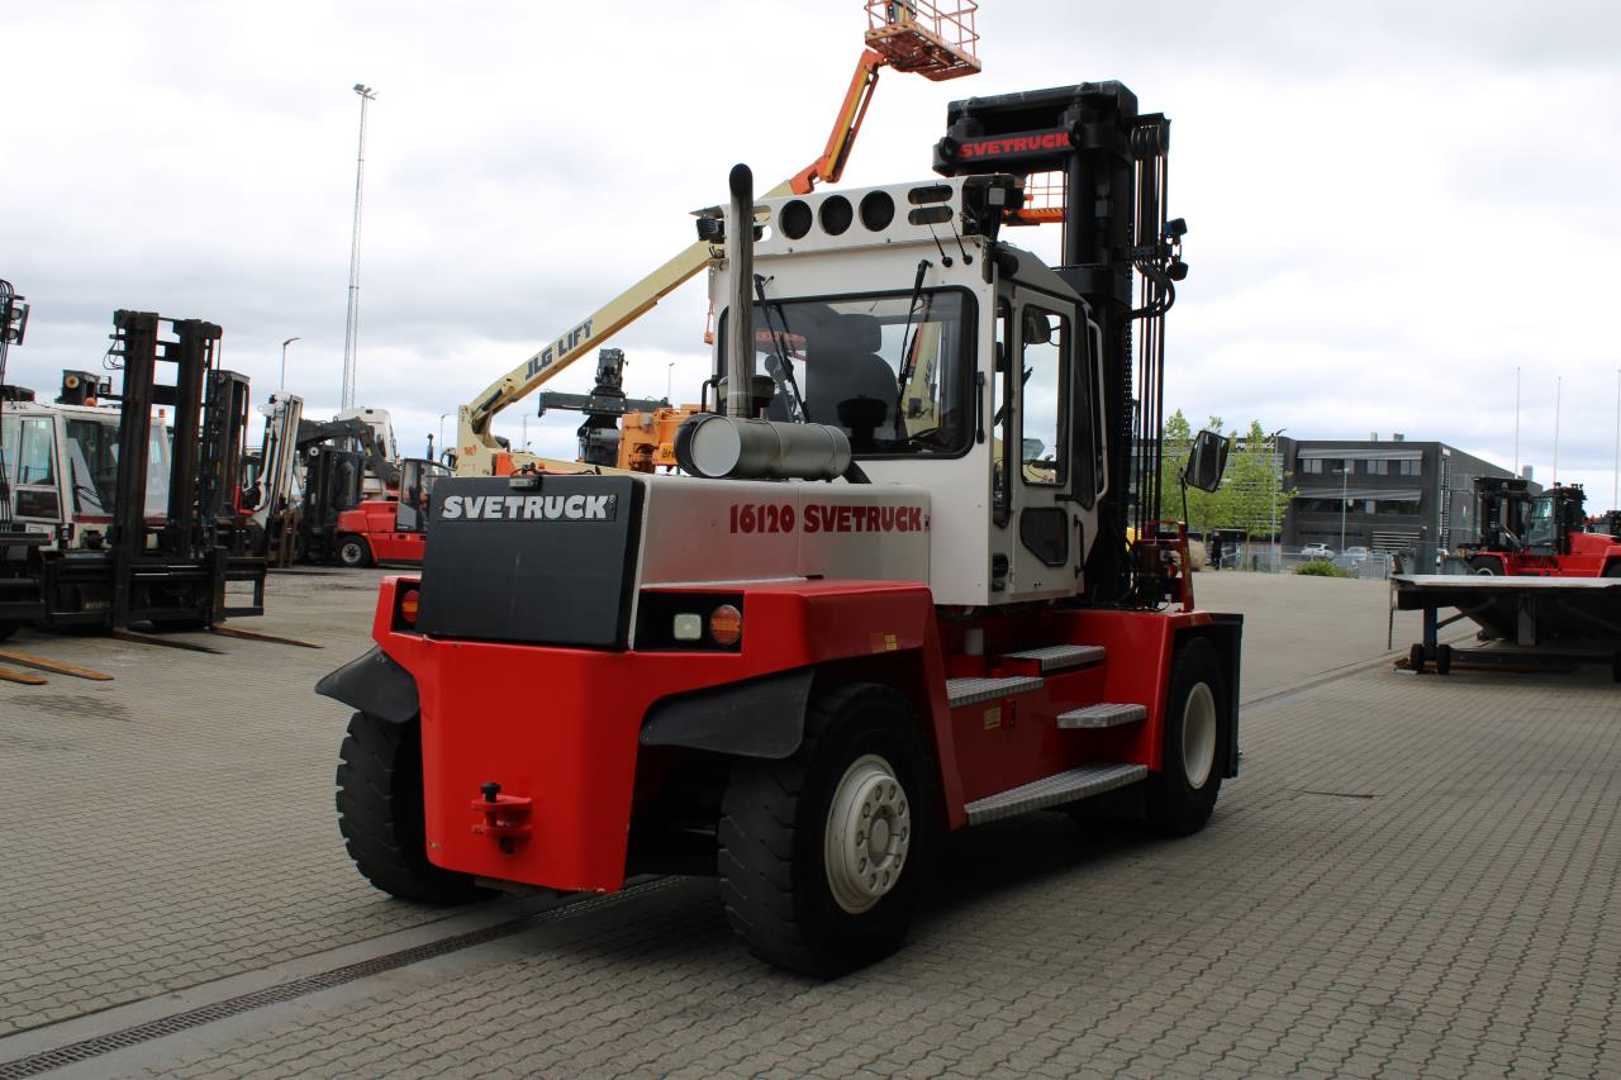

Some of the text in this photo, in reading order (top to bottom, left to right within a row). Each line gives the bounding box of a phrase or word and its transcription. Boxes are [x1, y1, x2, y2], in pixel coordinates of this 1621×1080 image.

[960, 132, 1070, 158] SVETRUCK
[525, 319, 593, 380] JLG LIFT
[442, 495, 607, 519] SVETRUCK
[730, 504, 922, 533] 16120 SVETRUCK
